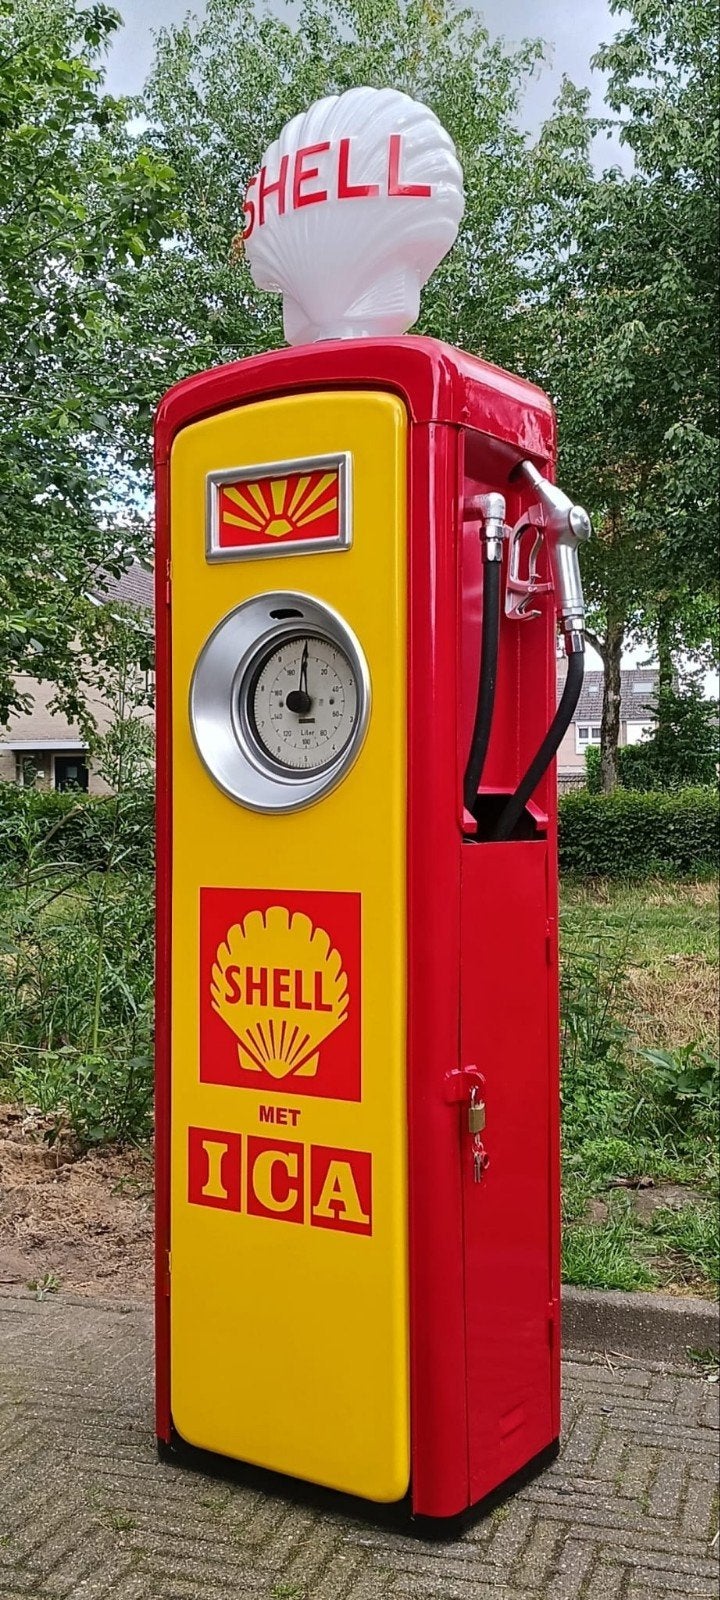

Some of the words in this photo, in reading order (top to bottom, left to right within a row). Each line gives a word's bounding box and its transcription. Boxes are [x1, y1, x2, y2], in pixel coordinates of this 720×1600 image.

[242, 134, 432, 240] SHELL
[320, 668, 328, 676] 20
[300, 729, 315, 737] Liter
[224, 964, 333, 1012] SHELL
[259, 1105, 301, 1127] MET
[201, 1139, 370, 1225] ICA
